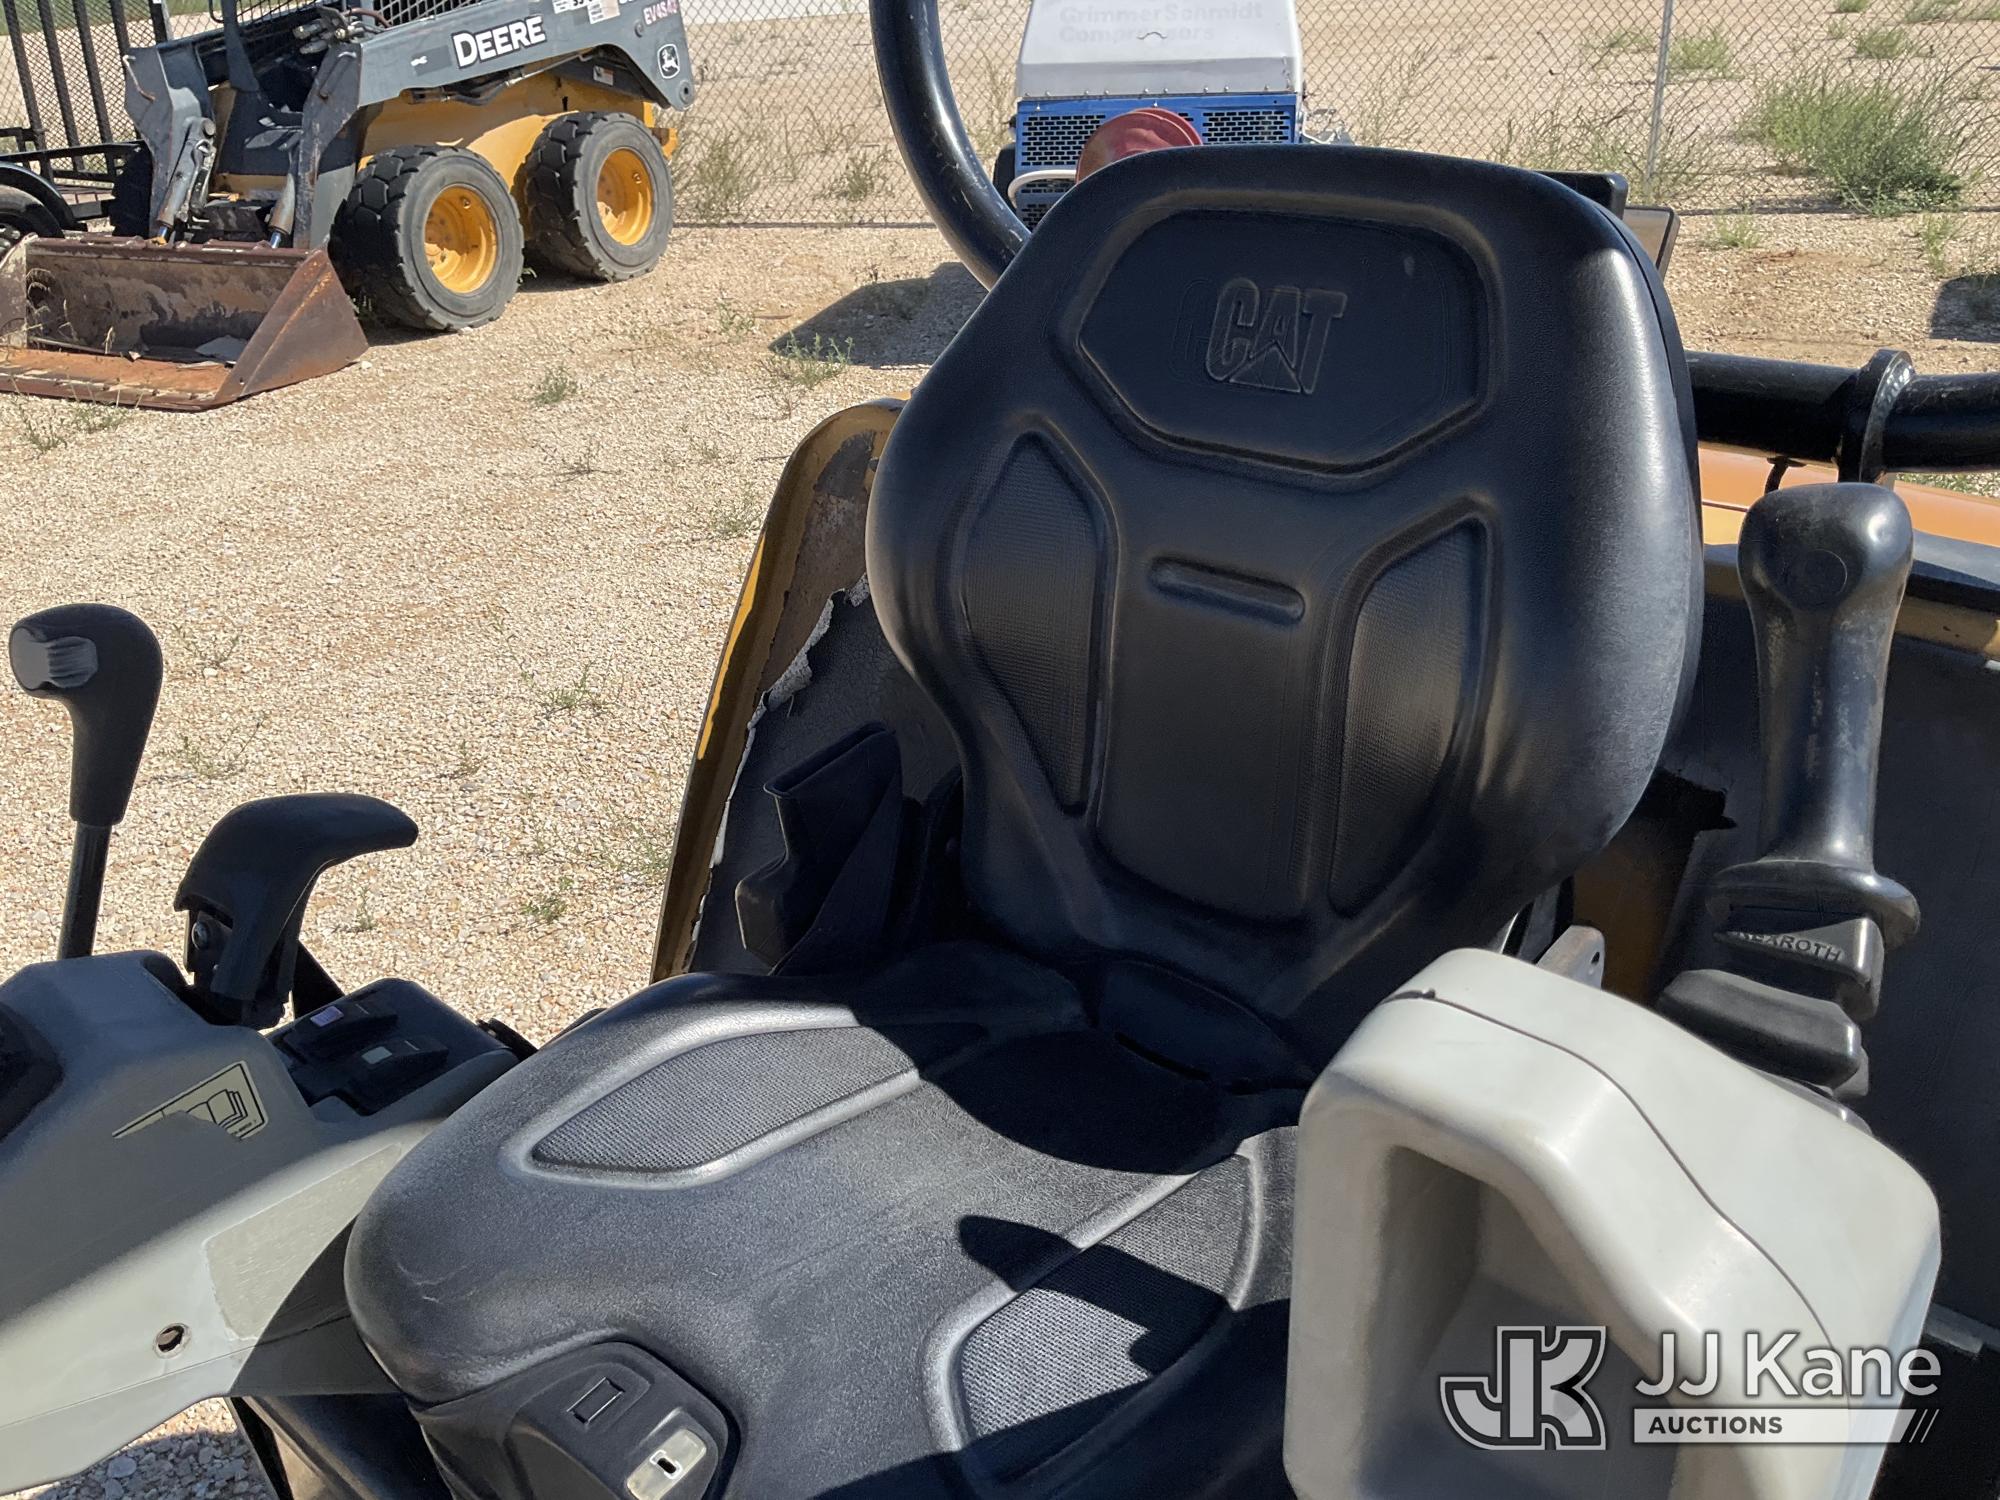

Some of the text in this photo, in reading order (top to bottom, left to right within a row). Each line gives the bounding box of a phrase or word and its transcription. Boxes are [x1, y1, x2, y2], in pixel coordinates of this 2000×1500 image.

[452, 15, 546, 68] DEERE
[1059, 26, 1215, 44] Comprsors
[1206, 277, 1348, 394] CAT
